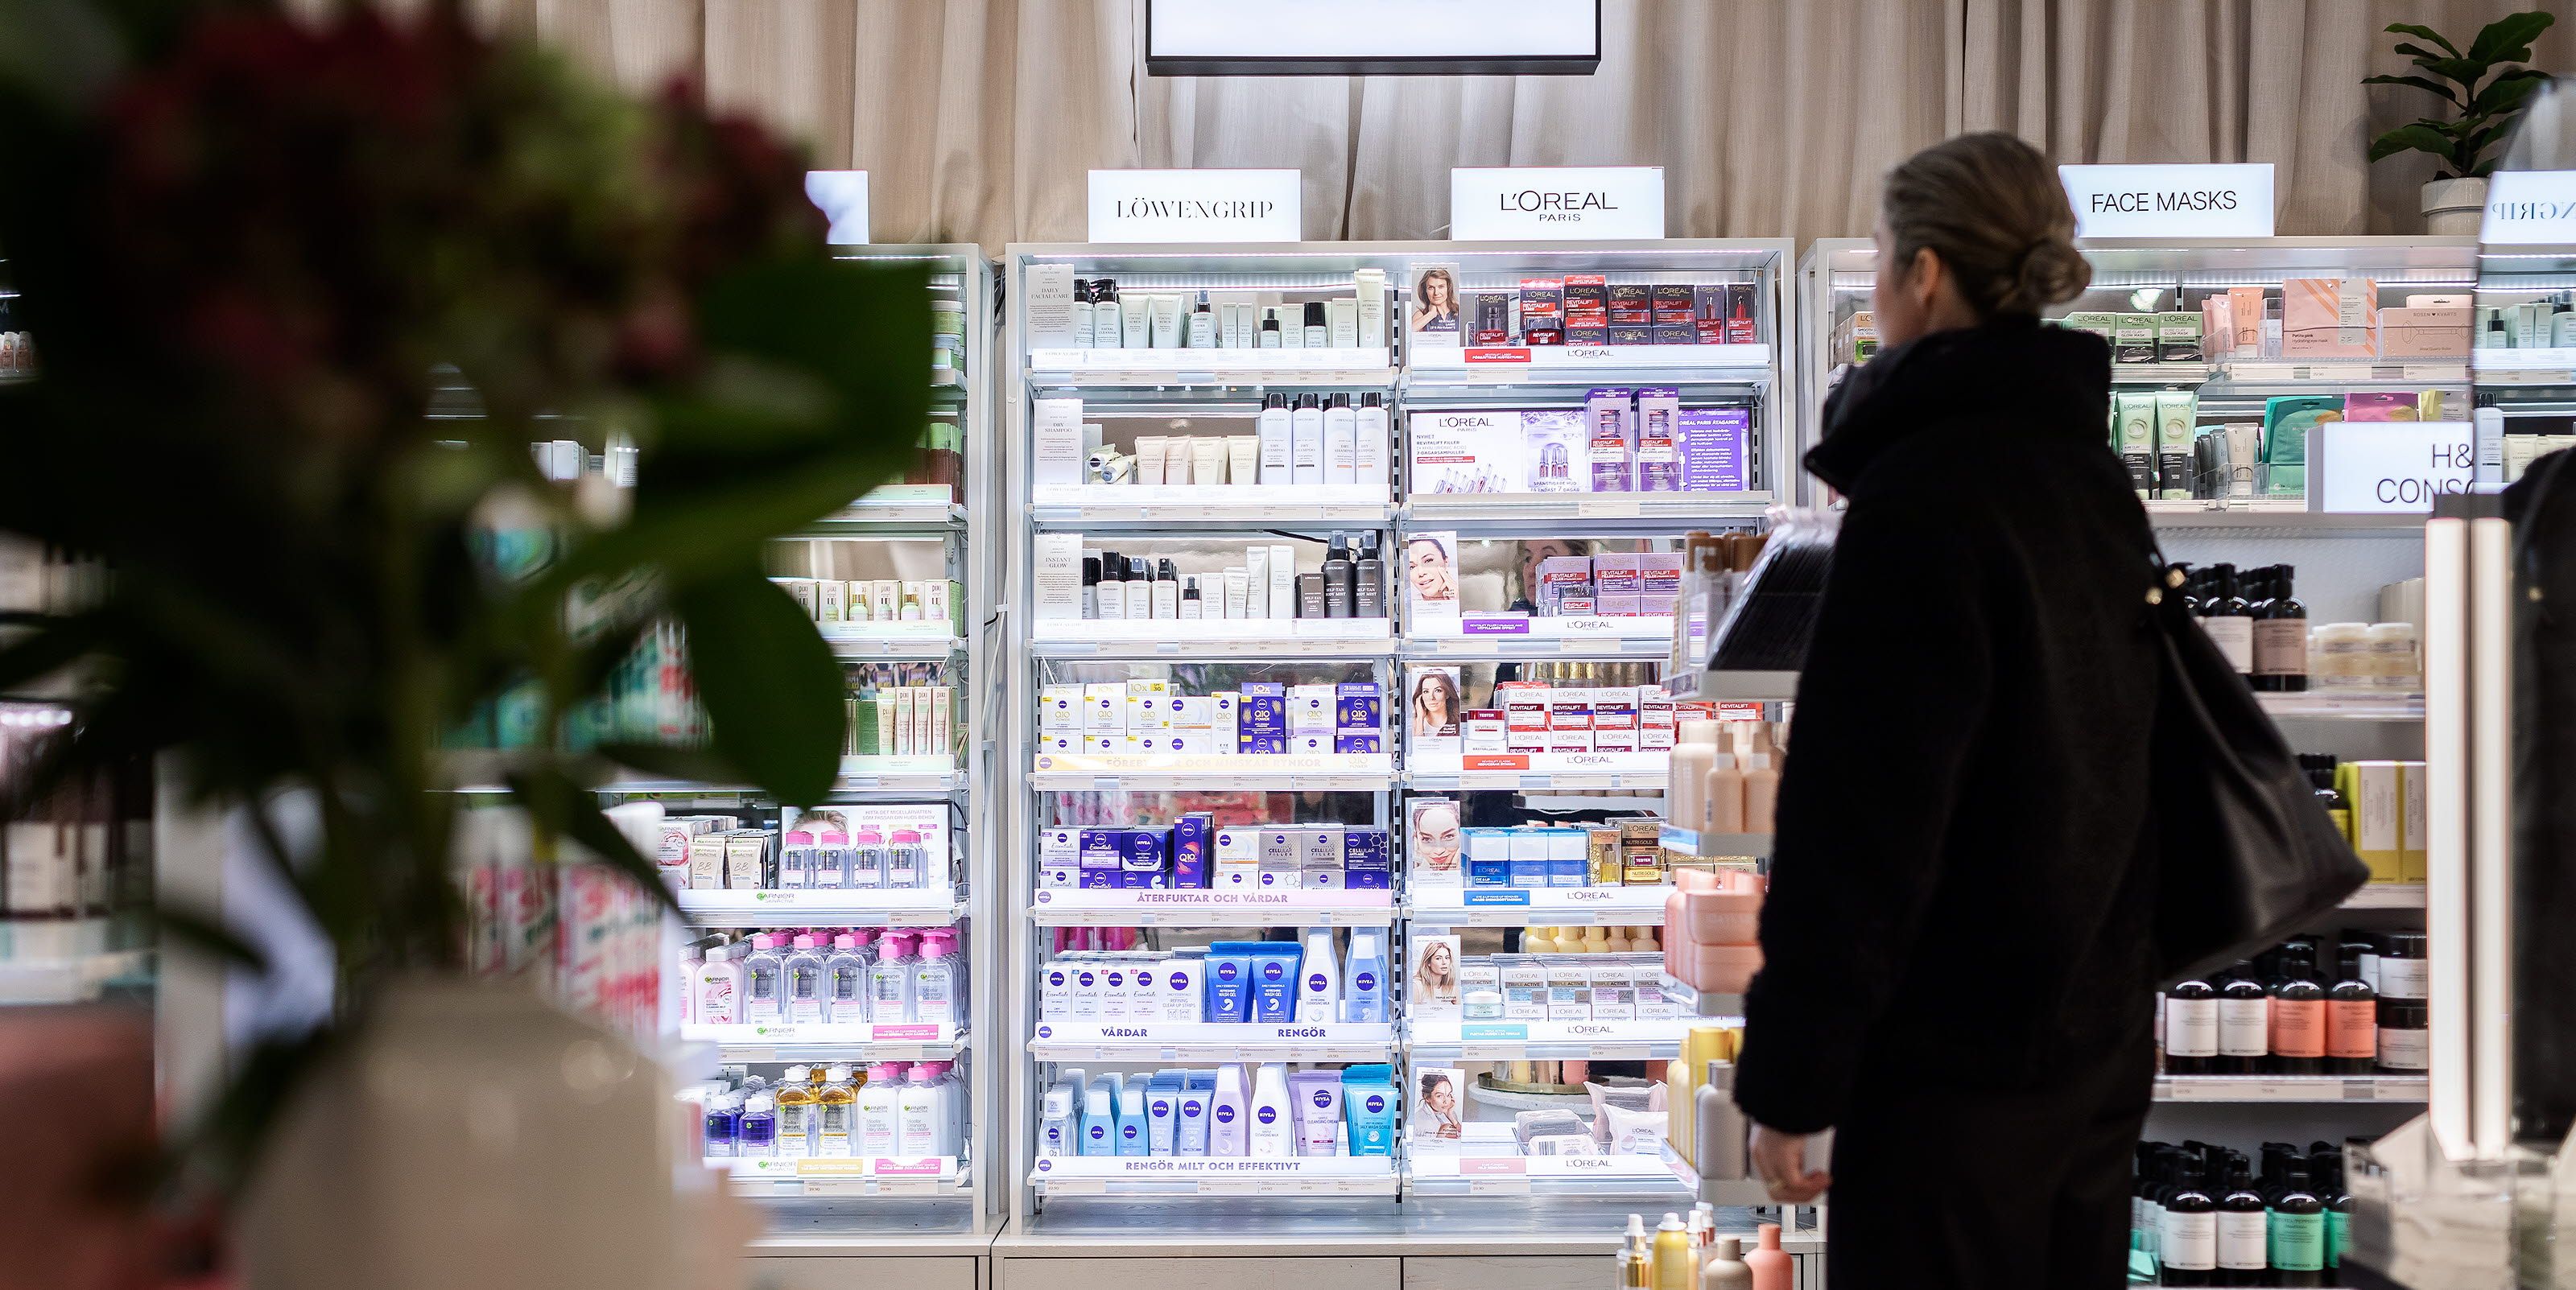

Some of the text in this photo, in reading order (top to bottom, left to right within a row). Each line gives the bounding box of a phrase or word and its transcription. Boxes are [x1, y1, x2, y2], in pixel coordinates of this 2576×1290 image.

[2092, 190, 2237, 212] FACE MASKS
[1117, 197, 1274, 218] LÖWENGRIP
[1184, 759, 1211, 767] OCH
[1272, 759, 1321, 767] RYNKOR
[697, 861, 712, 871] BB
[734, 861, 749, 871] BB
[1137, 893, 1209, 902] ÅTERFUKTAR
[1242, 893, 1288, 902] VÅRDAR
[1101, 1027, 1148, 1037] VÅRDAR
[1278, 1027, 1326, 1037] RENGÖR
[1126, 1160, 1174, 1170] RENGÖR
[1208, 1162, 1233, 1170] OCH
[1238, 1162, 1301, 1170] EFFEKTIVT
